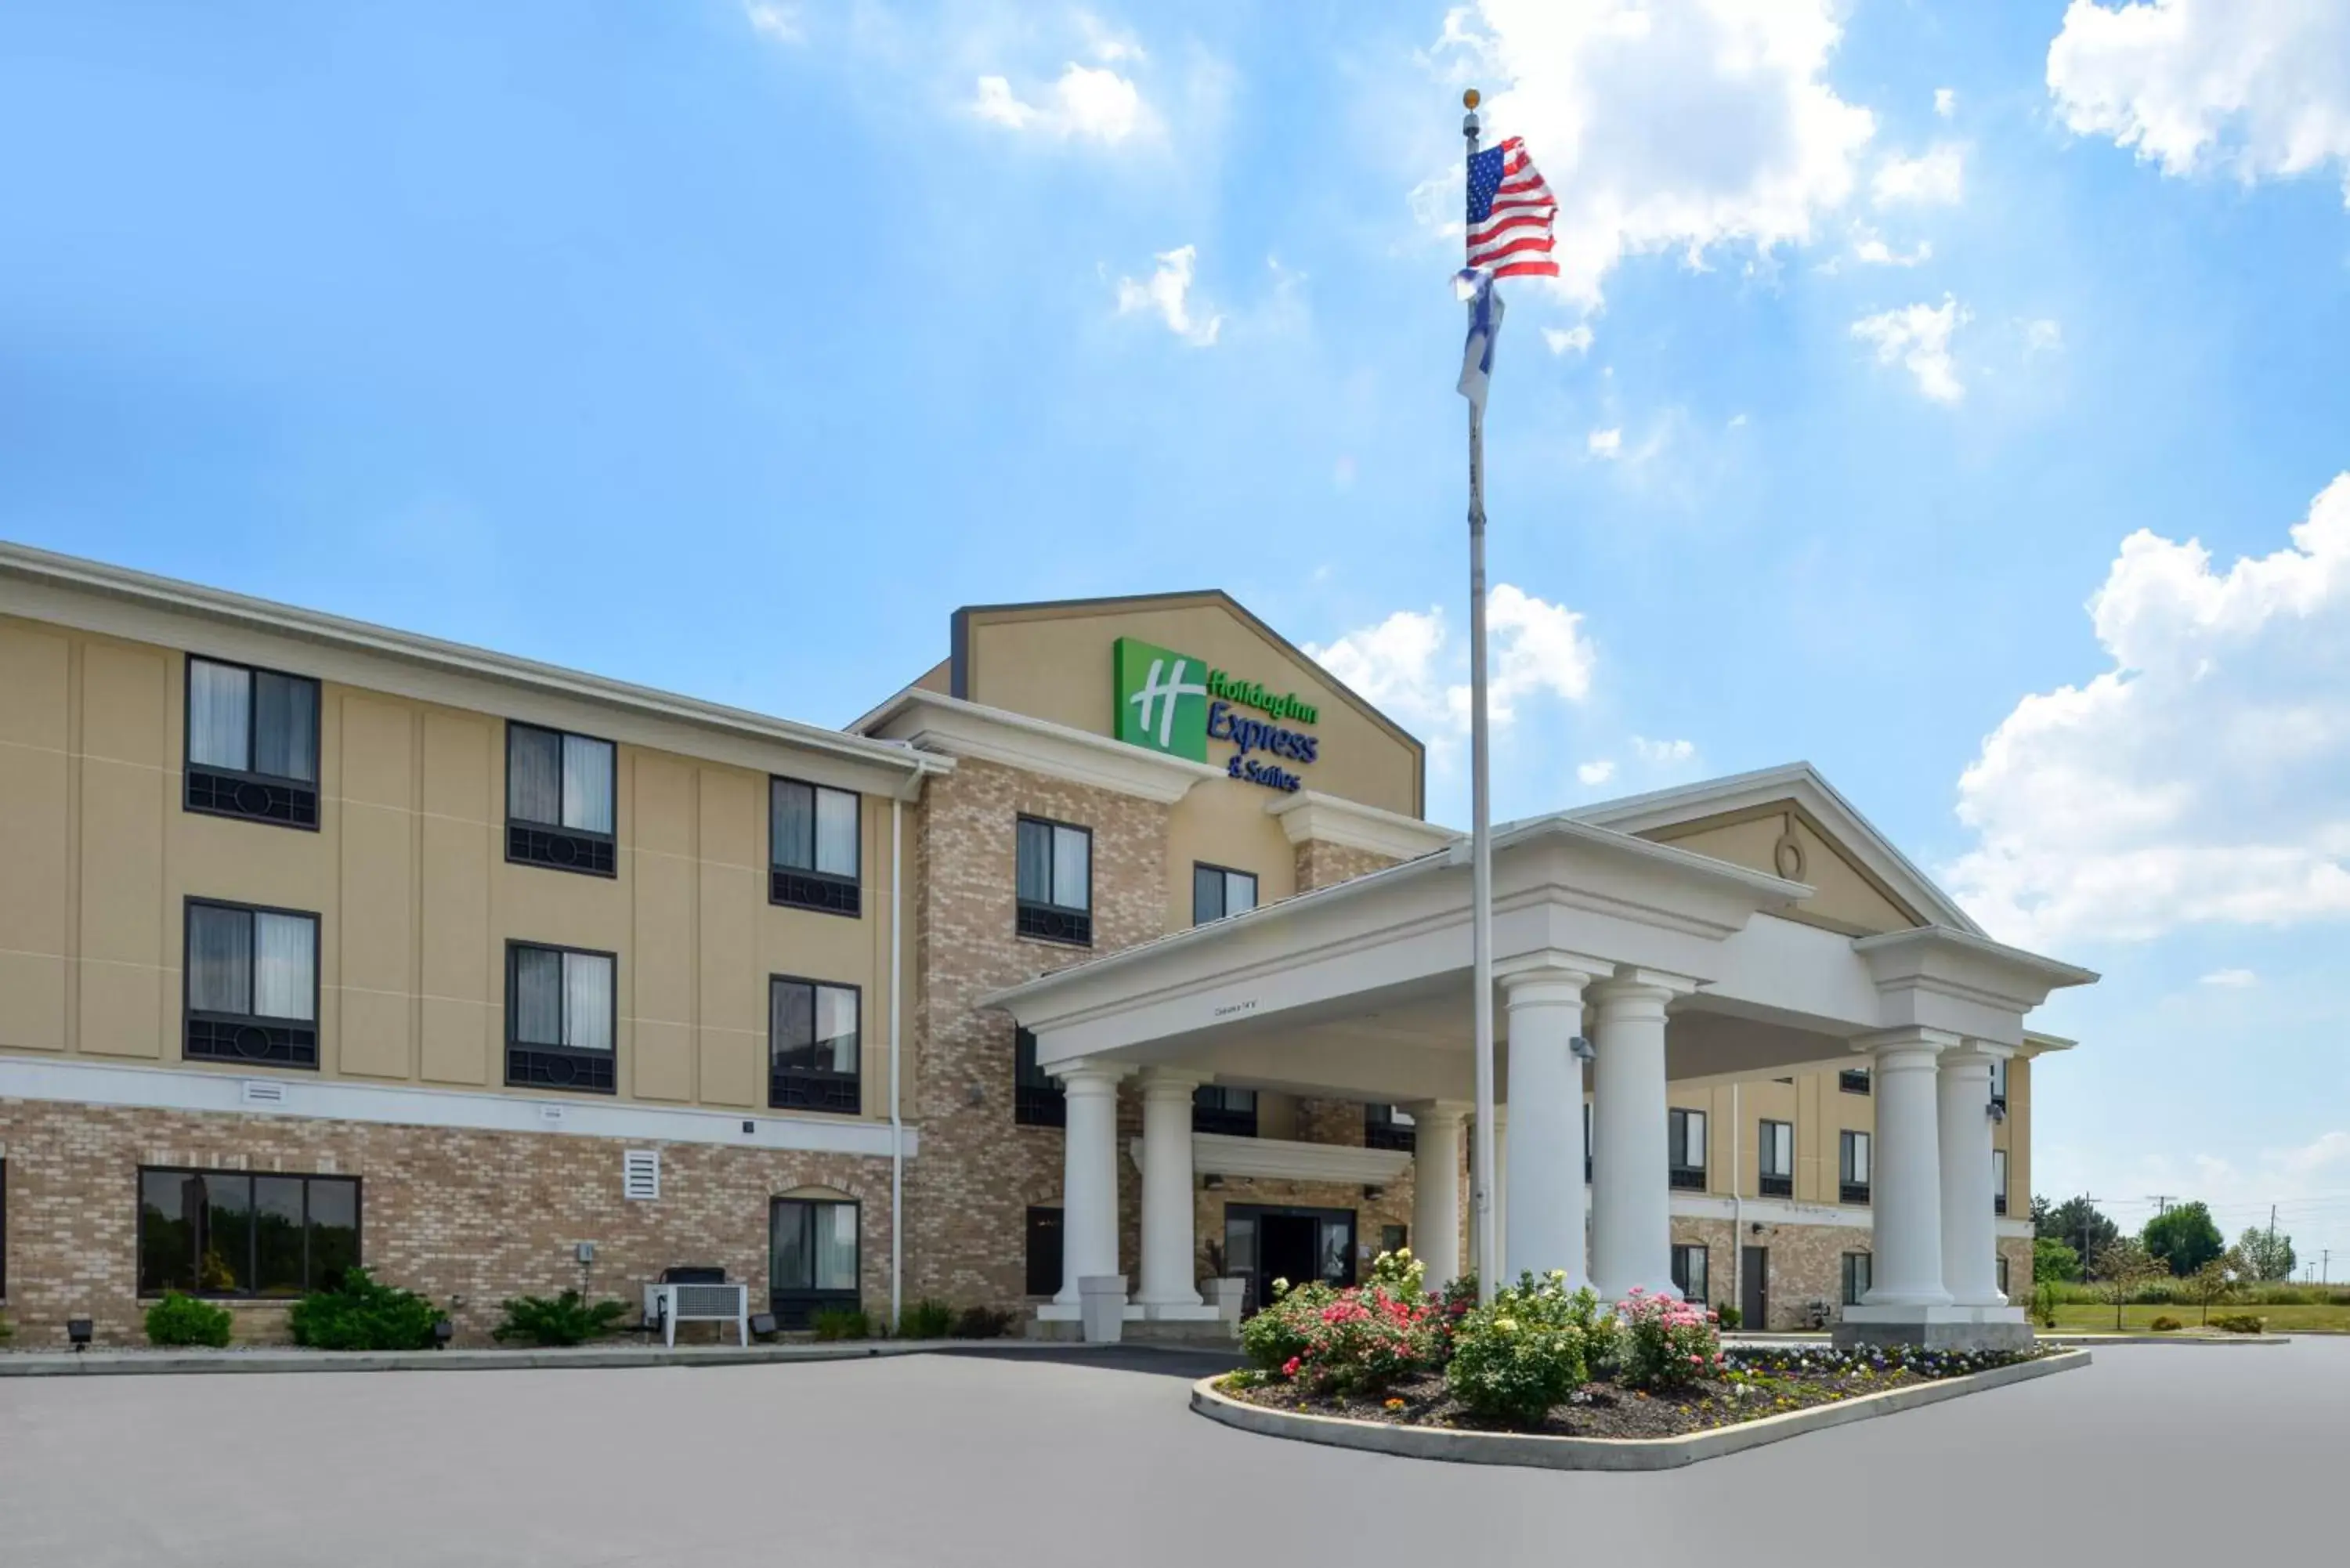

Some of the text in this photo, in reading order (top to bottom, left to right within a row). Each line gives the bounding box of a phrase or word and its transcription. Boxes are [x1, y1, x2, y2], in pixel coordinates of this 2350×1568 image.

[1207, 701, 1318, 764] Express
[1227, 754, 1301, 793] & Suites
